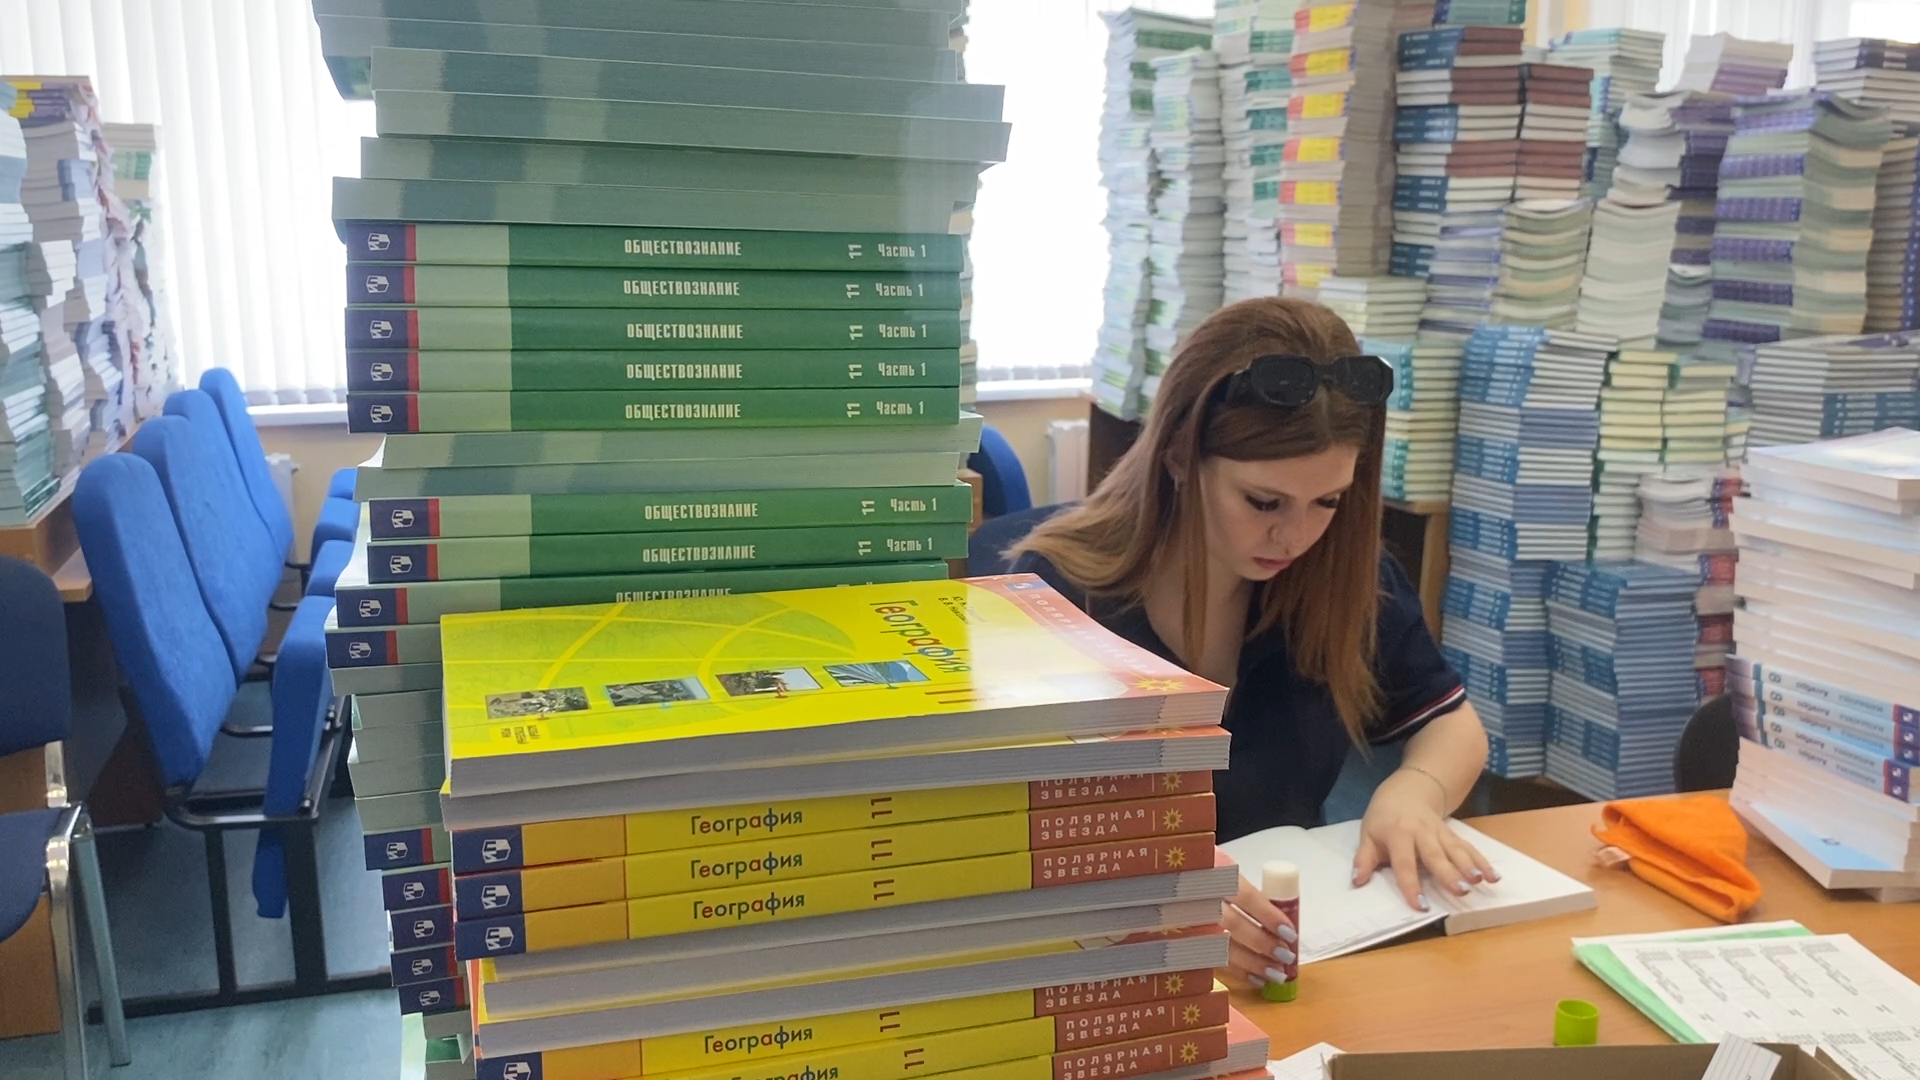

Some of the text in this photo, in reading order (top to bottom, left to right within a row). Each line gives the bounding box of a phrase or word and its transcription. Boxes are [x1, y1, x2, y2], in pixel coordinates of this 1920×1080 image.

[624, 239, 742, 256] ОБЩЕСТВОЗНАНИЕ
[848, 244, 862, 259] 11
[877, 243, 915, 257] Часть
[623, 280, 740, 297] ОБЩЕСТВОЗНАНИЕ
[846, 284, 860, 299] 11
[875, 283, 912, 297] Часть
[627, 323, 743, 341] ОБЩЕСТВОЗНАНИЕ
[849, 324, 863, 341] 11
[879, 323, 916, 338] Часть
[626, 364, 743, 381] ОБЩЕСТВОЗНАНИЕ
[848, 364, 862, 380] 11
[878, 362, 915, 377] Часть
[625, 404, 741, 421] ОБЩЕСТВОЗНАНИЕ
[846, 403, 860, 418] 11
[876, 401, 912, 415] Часть
[644, 503, 759, 521] ОБЩЕСТВОЗНАНИЕ
[861, 500, 875, 516] 11
[890, 498, 926, 512] Часть
[858, 541, 871, 556] 11
[887, 538, 922, 552] Часть
[643, 545, 756, 564] ОБЩЕСТВОЗНАНИЕ
[869, 600, 972, 674] География
[1041, 784, 1118, 800] ЗВЕЗДА
[870, 797, 892, 819] 11
[691, 808, 803, 836] География
[1041, 808, 1145, 828] ПОЛЯРНАЯ
[1041, 823, 1119, 840] ЗВЕЗДА
[871, 839, 893, 860] 11
[1044, 847, 1148, 867] ПОЛЯРНАЯ
[691, 851, 803, 879] География
[1044, 862, 1121, 880] ЗВЕЗДА
[873, 879, 894, 901] 11
[693, 892, 805, 920] География
[1045, 975, 1148, 996] ПОЛЯРНАЯ
[1045, 991, 1121, 1008] ЗВЕЗДА
[879, 1011, 900, 1033] 11
[1066, 1005, 1166, 1030] ПОЛЯРНАЯ
[704, 1026, 813, 1054] География
[1066, 1021, 1140, 1042] ЗВЕЗДА
[904, 1048, 925, 1070] 11
[1064, 1044, 1163, 1070] ПОЛЯРНАЯ
[1064, 1060, 1138, 1080] ЗВЕЗДА
